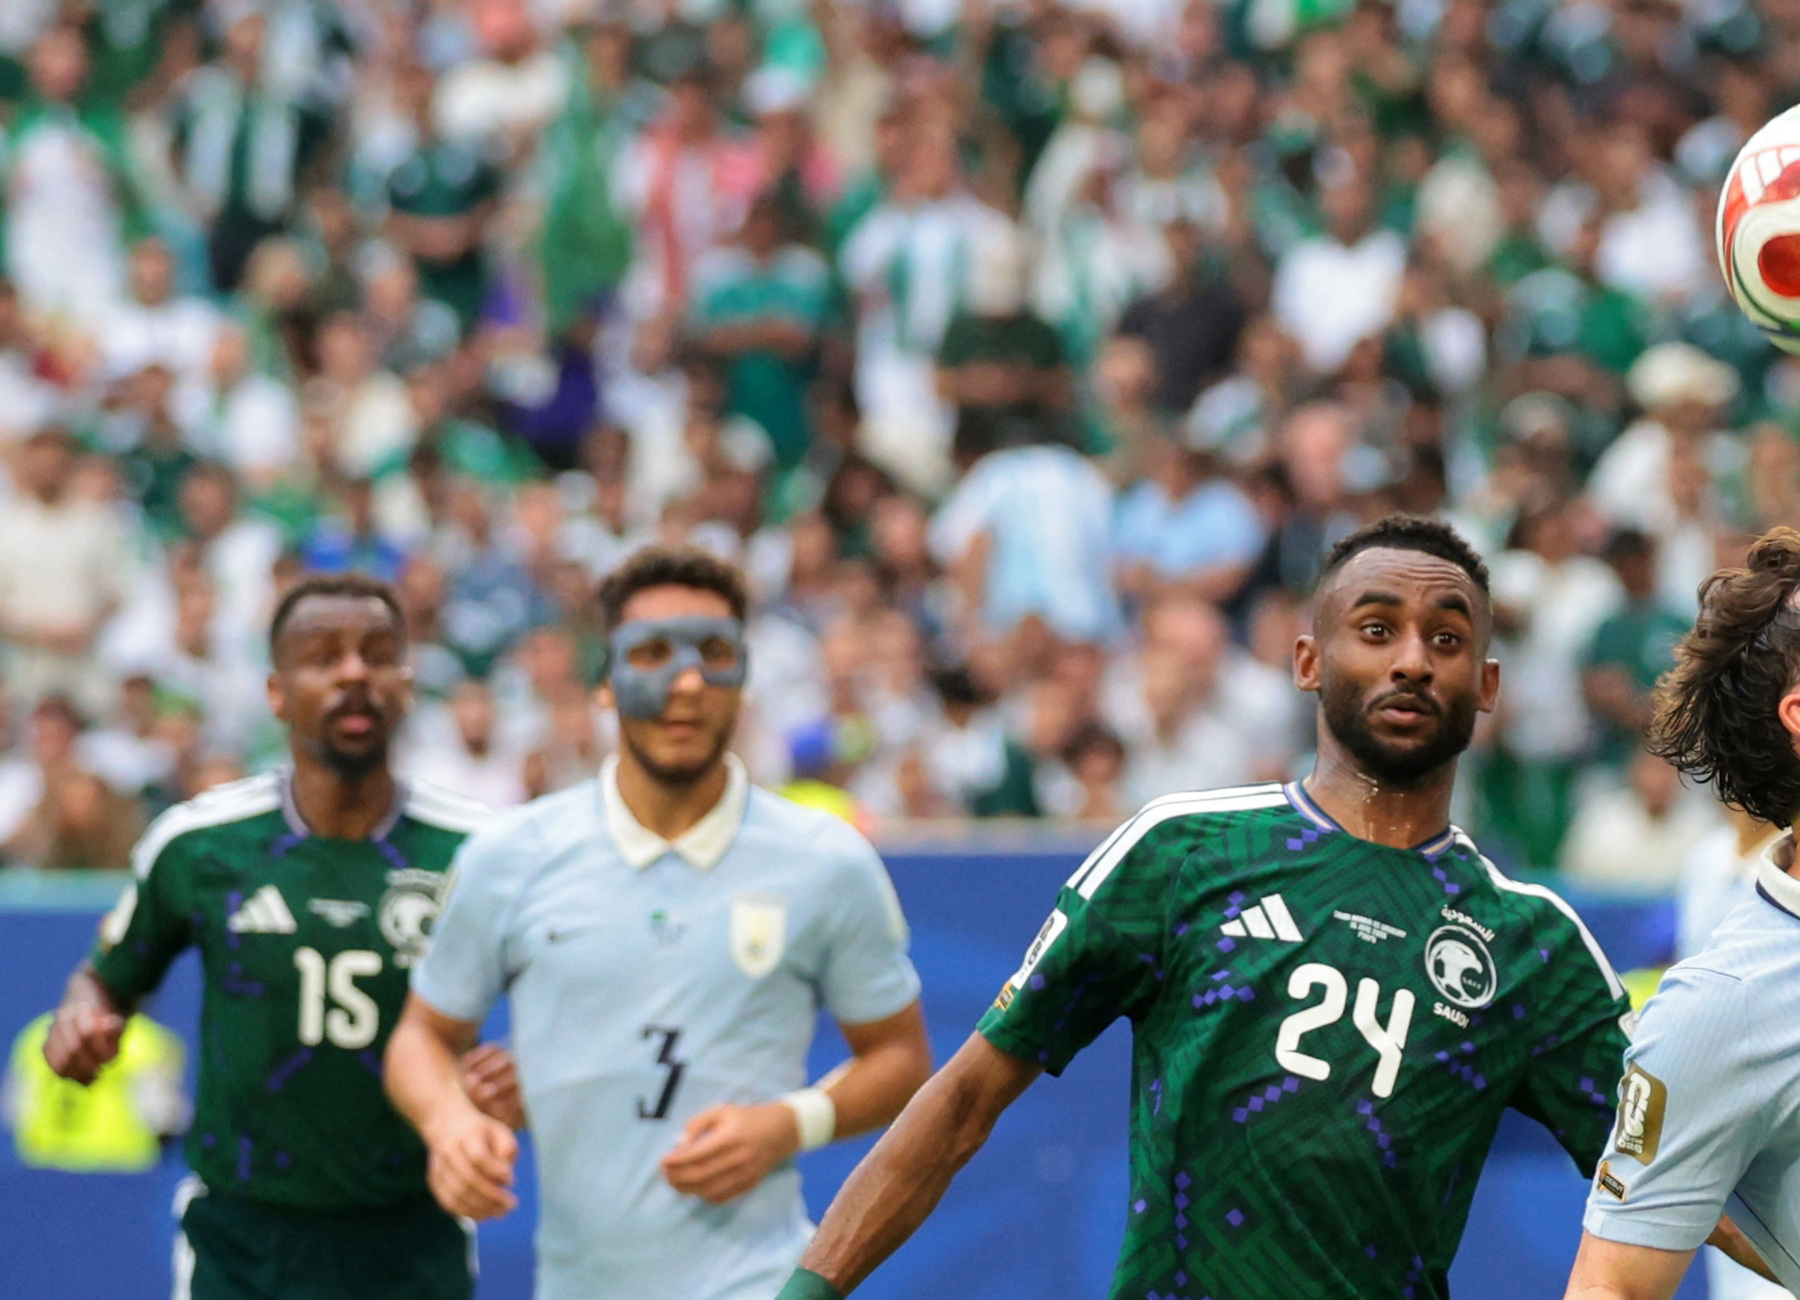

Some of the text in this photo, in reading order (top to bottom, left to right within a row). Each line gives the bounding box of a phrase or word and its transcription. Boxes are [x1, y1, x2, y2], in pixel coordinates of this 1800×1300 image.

[293, 946, 383, 1050] 15
[1275, 962, 1415, 1098] 24
[638, 1025, 686, 1119] 3
